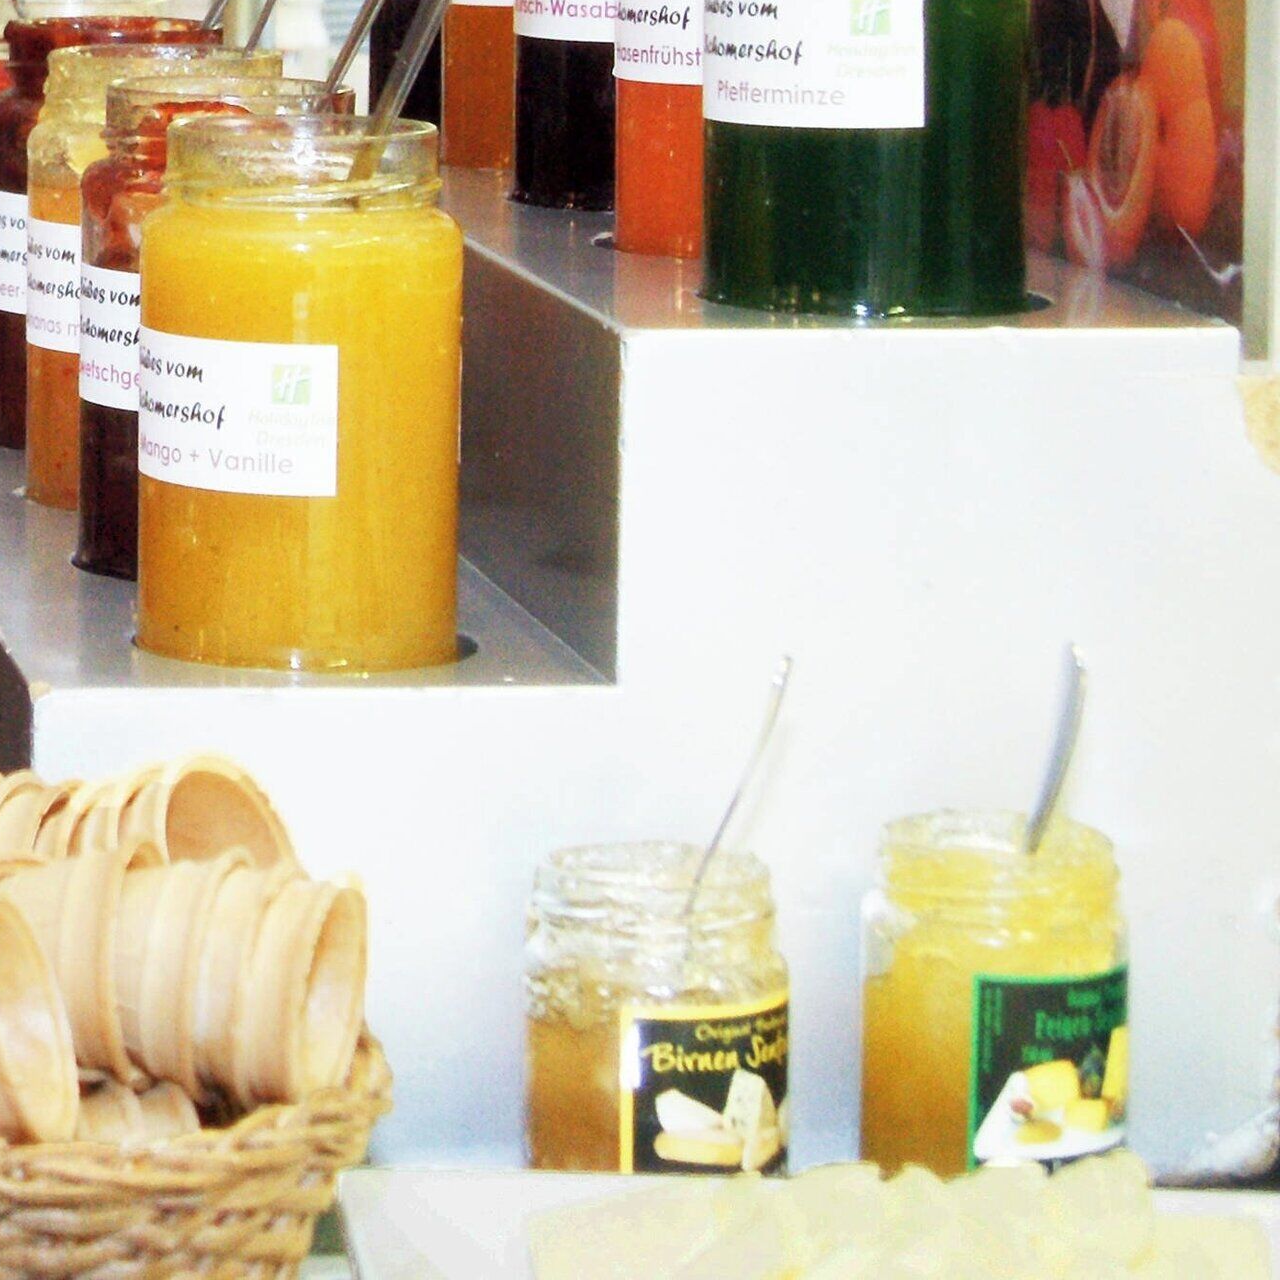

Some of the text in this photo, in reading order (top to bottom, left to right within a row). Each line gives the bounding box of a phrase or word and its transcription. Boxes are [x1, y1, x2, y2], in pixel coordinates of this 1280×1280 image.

[737, 0, 778, 20] vom
[617, 43, 702, 67] asenfrühst
[717, 79, 846, 107] Pfefferminze
[45, 249, 76, 266] vom
[166, 361, 203, 383] vom
[208, 447, 293, 474] Vanille
[641, 1041, 739, 1074] Birnen
